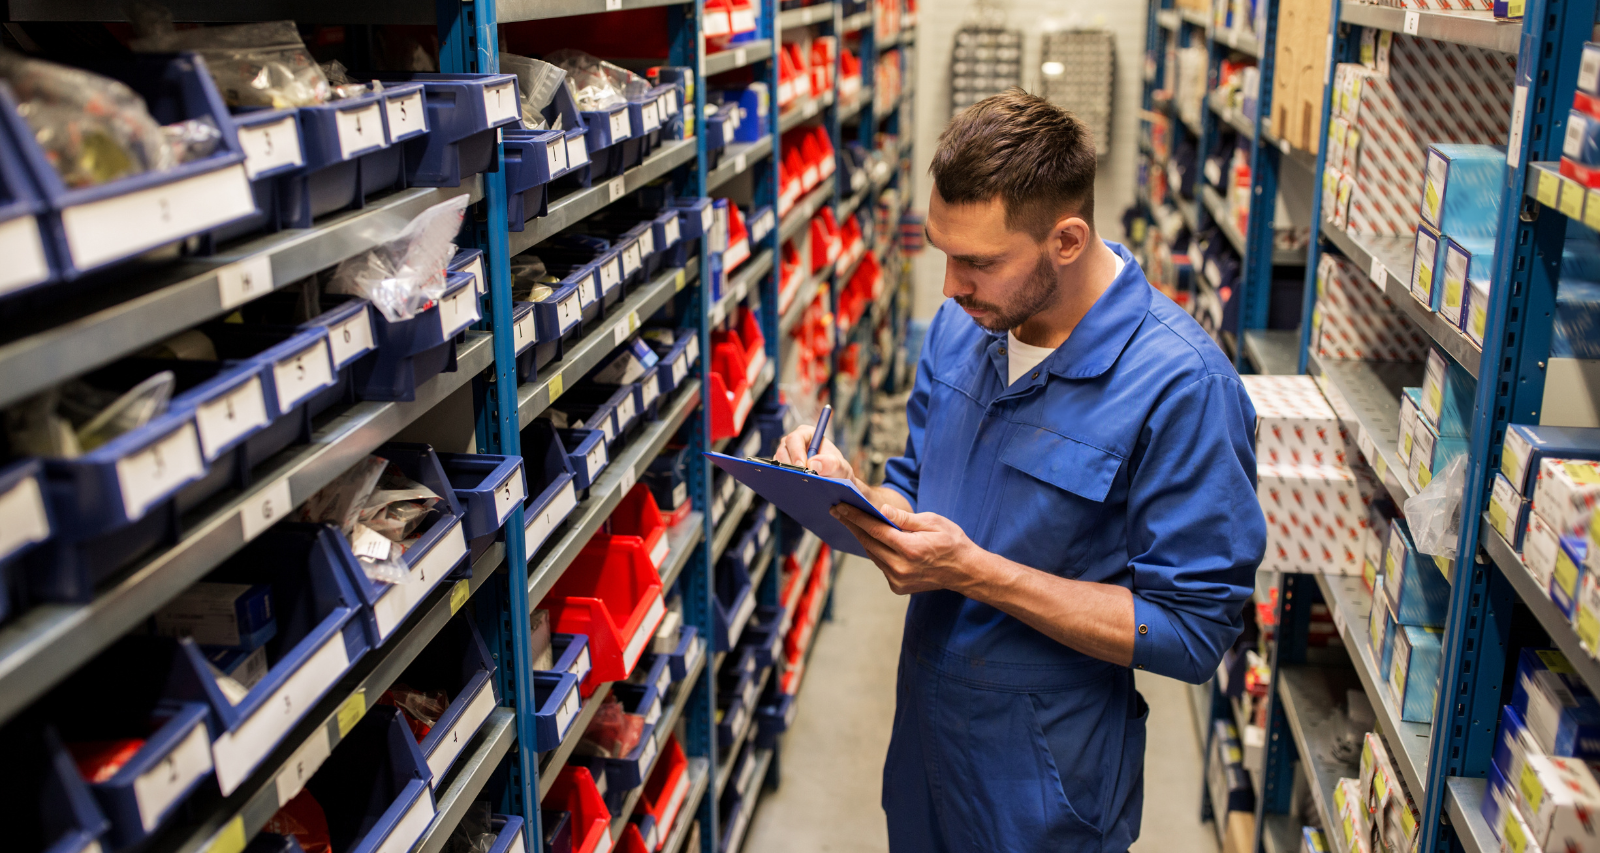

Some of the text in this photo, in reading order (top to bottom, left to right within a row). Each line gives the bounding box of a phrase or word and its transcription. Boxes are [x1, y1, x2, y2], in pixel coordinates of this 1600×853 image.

[296, 356, 306, 381] 5
[504, 482, 511, 501] 5
[420, 568, 426, 582] 4
[453, 730, 459, 743] 4
